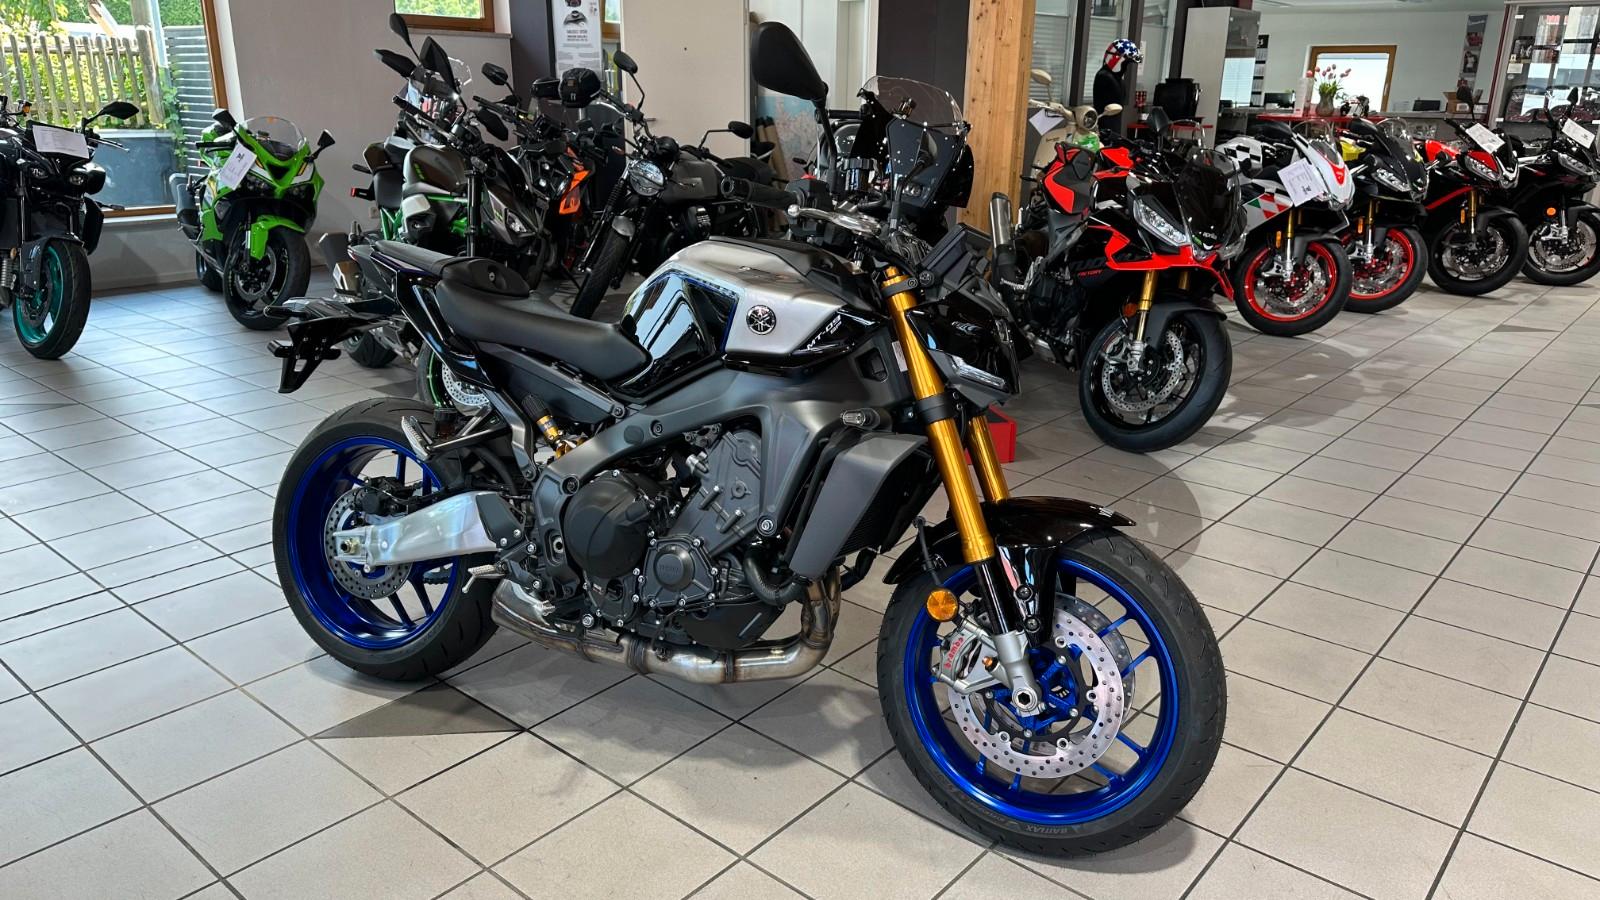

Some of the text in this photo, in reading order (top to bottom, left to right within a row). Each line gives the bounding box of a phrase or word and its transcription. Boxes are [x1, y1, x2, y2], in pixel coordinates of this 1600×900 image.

[806, 314, 841, 351] MT-09
[943, 636, 964, 669] brembo
[1024, 824, 1068, 835] BATTLAX
